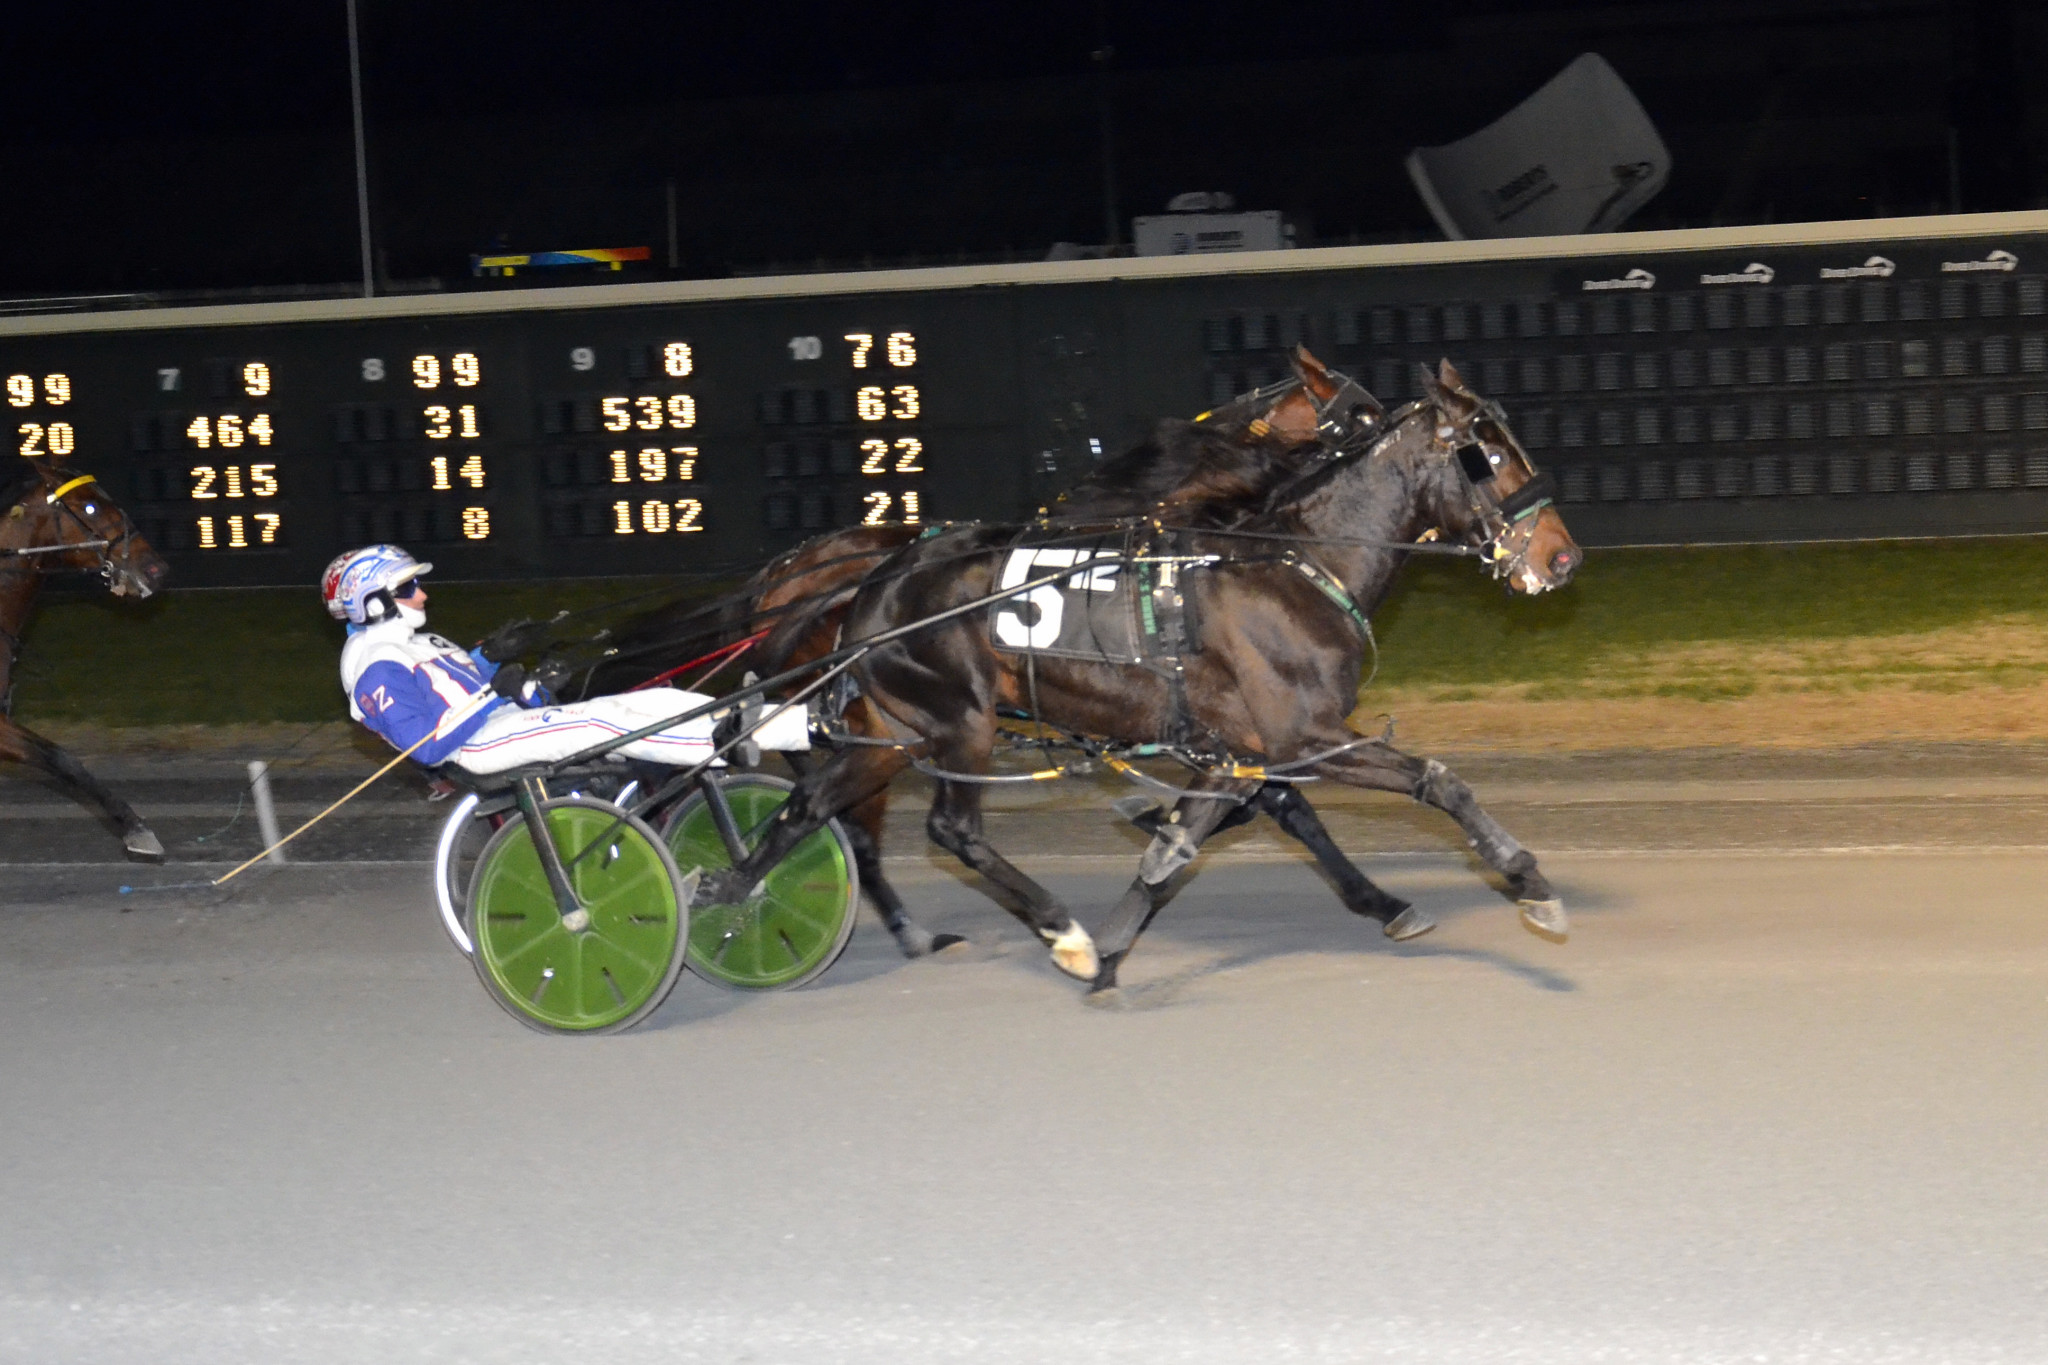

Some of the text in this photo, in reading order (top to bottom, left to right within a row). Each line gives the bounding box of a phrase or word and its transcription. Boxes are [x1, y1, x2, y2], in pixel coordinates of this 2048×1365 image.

[572, 348, 594, 370] 9
[664, 343, 692, 376] 8
[789, 337, 821, 360] 10
[159, 369, 178, 390] 7
[244, 363, 270, 396] 9
[363, 359, 384, 380] 8
[602, 395, 696, 431] 539
[857, 386, 919, 420] 63
[187, 414, 273, 448] 464
[424, 405, 480, 438] 31
[19, 423, 74, 456] 20
[860, 438, 923, 473] 22
[191, 464, 277, 498] 215
[431, 456, 485, 489] 14
[610, 447, 698, 482] 197
[463, 507, 489, 539] 8
[613, 499, 703, 533] 102
[862, 492, 919, 526] 21
[197, 514, 280, 548] 117
[996, 548, 1077, 649] 5
